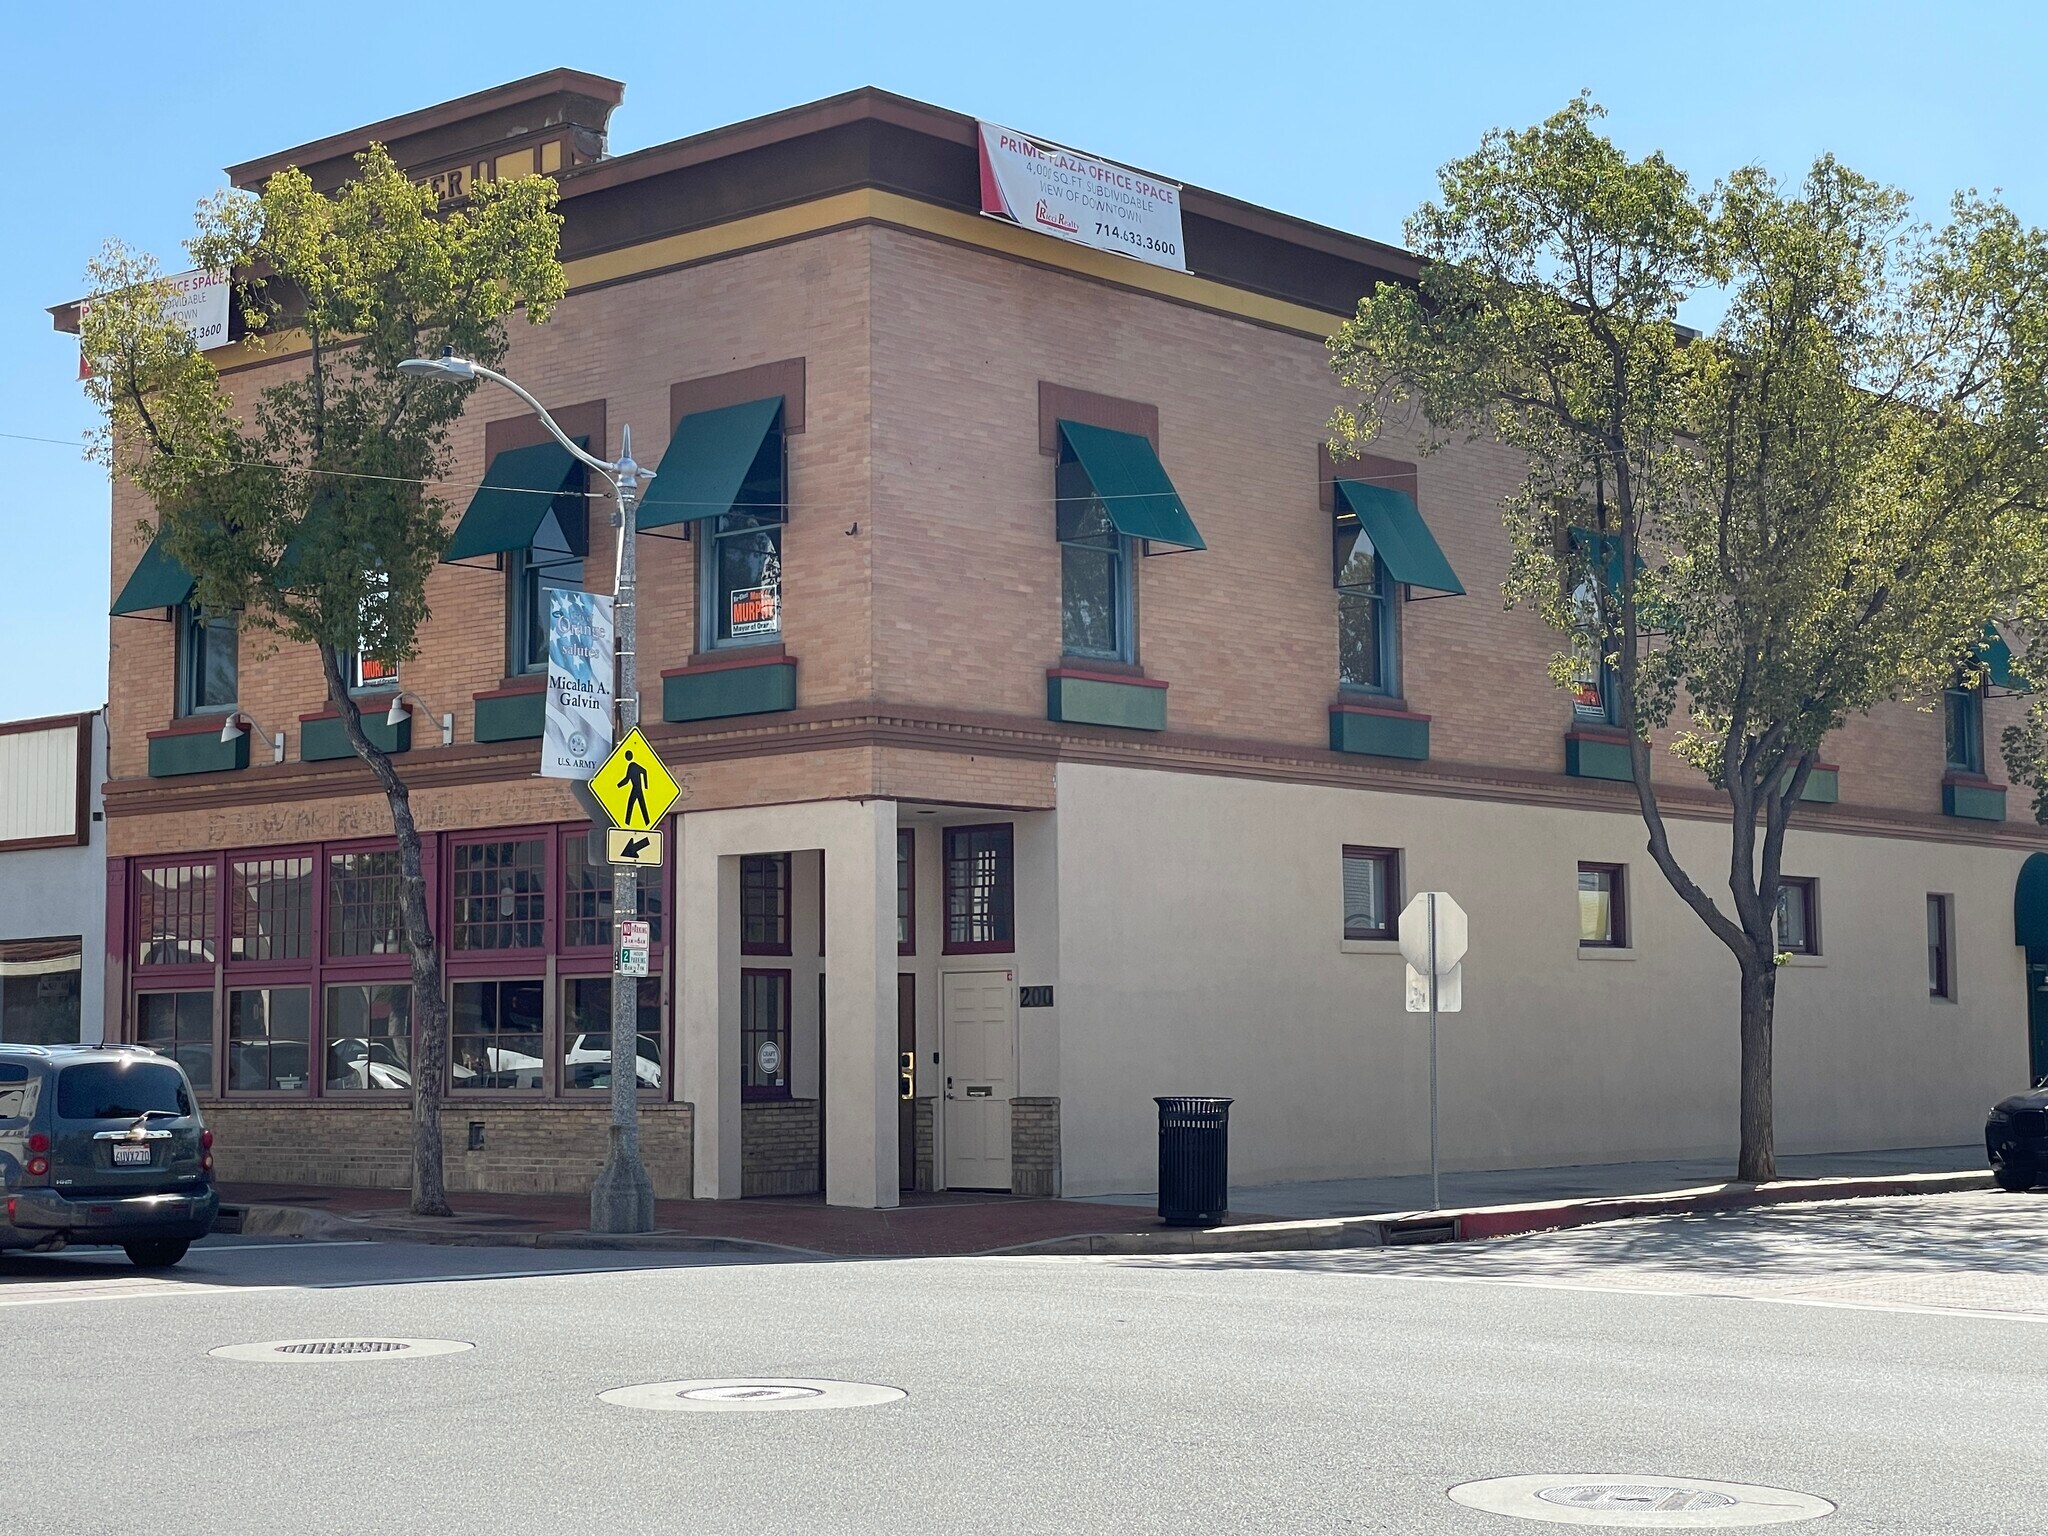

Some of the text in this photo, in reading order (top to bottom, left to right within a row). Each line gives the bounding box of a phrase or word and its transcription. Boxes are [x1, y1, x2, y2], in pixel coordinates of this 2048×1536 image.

[1000, 135, 1173, 204] PRIME PLAZA OFFICE SPACE
[1026, 162, 1052, 179] 4,000
[1087, 182, 1154, 212] SUBDIVIDABLE
[1040, 181, 1142, 224] VIEW OF DOWNTOWN
[1095, 223, 1176, 255] 714.633.3600
[557, 615, 606, 641] Orange
[733, 624, 750, 632] Mayor
[562, 643, 600, 659] salutes
[549, 676, 610, 695] Micalah A.
[560, 692, 600, 710] Galvin
[557, 757, 597, 769] U.S. ARMY
[623, 923, 648, 935] NO PARKING
[623, 951, 629, 962] 2
[1020, 987, 1053, 1006] 200
